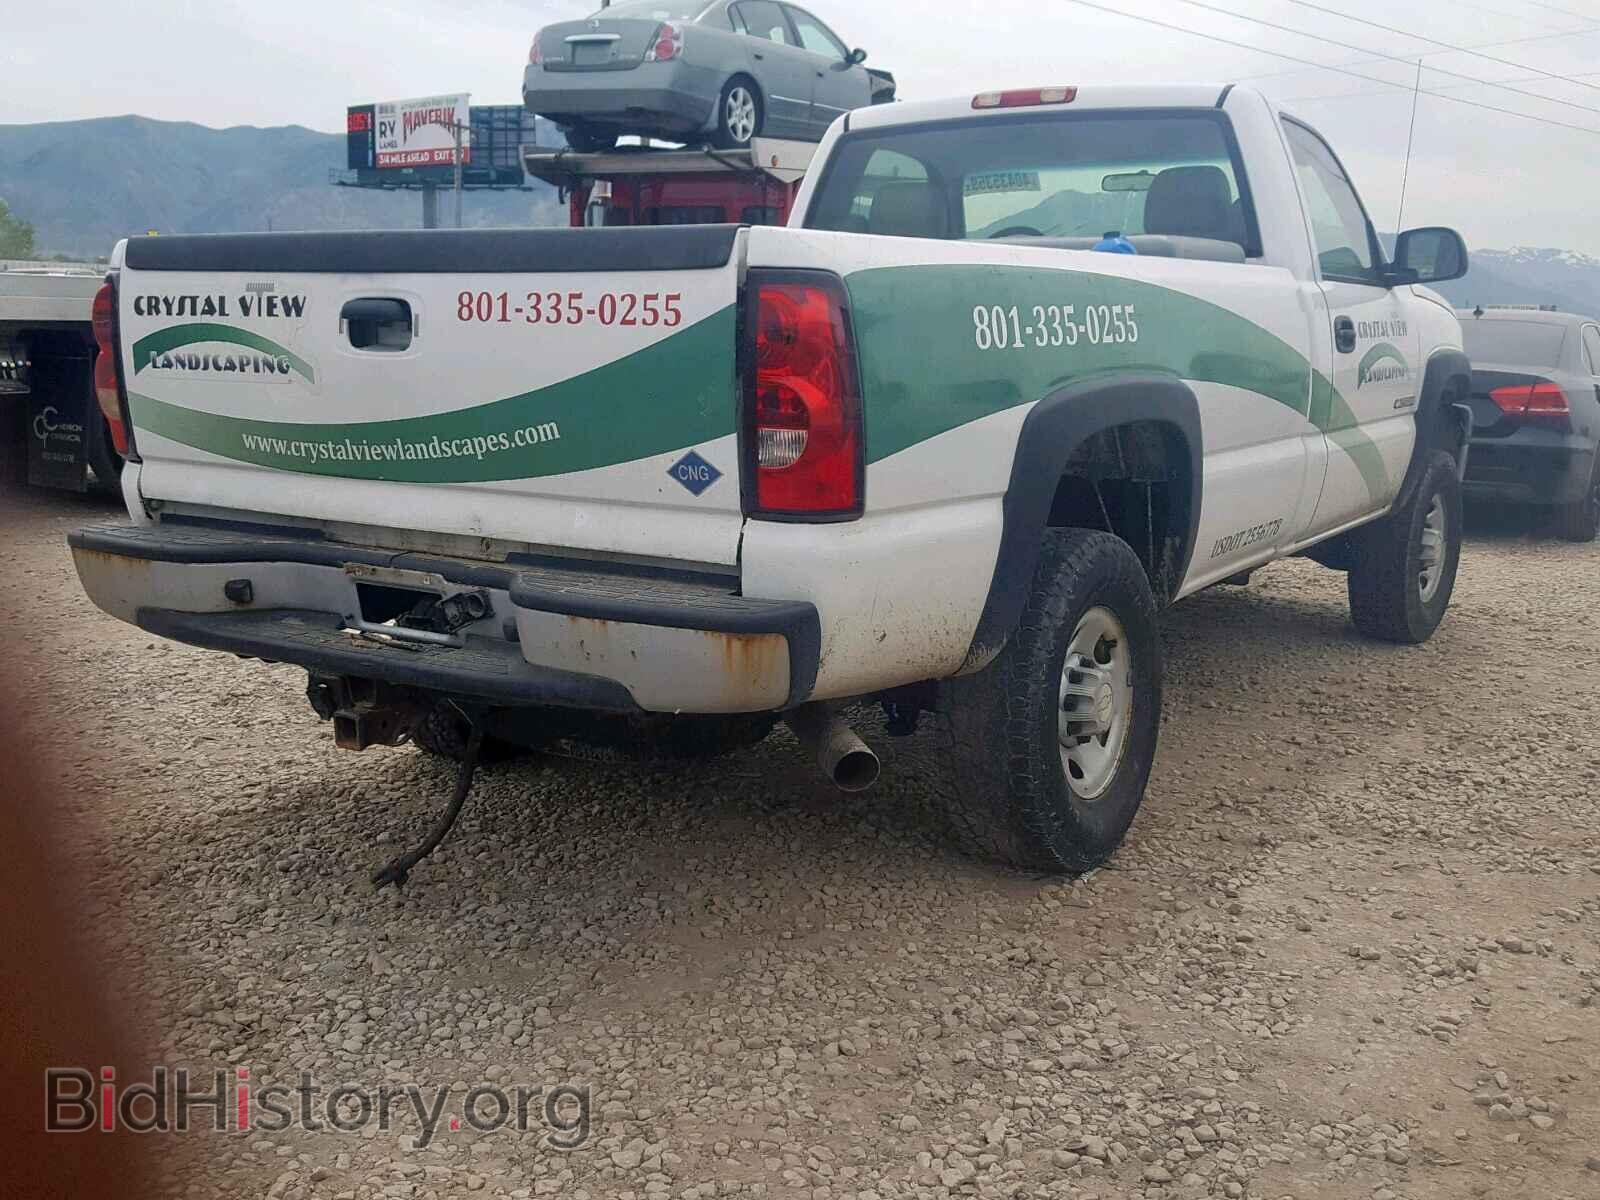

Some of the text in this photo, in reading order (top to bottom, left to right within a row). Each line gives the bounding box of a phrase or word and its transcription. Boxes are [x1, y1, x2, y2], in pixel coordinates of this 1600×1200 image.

[379, 120, 396, 138] RV
[434, 150, 450, 161] EXIT
[134, 295, 307, 318] CRYSTAL VIEW
[457, 291, 682, 327] 801-335-0255
[972, 303, 1139, 350] 801-335-0255
[150, 351, 291, 375] LANDSCAPING
[241, 419, 561, 464] www.crystalviewlandscapes.com
[677, 464, 710, 481] CNG
